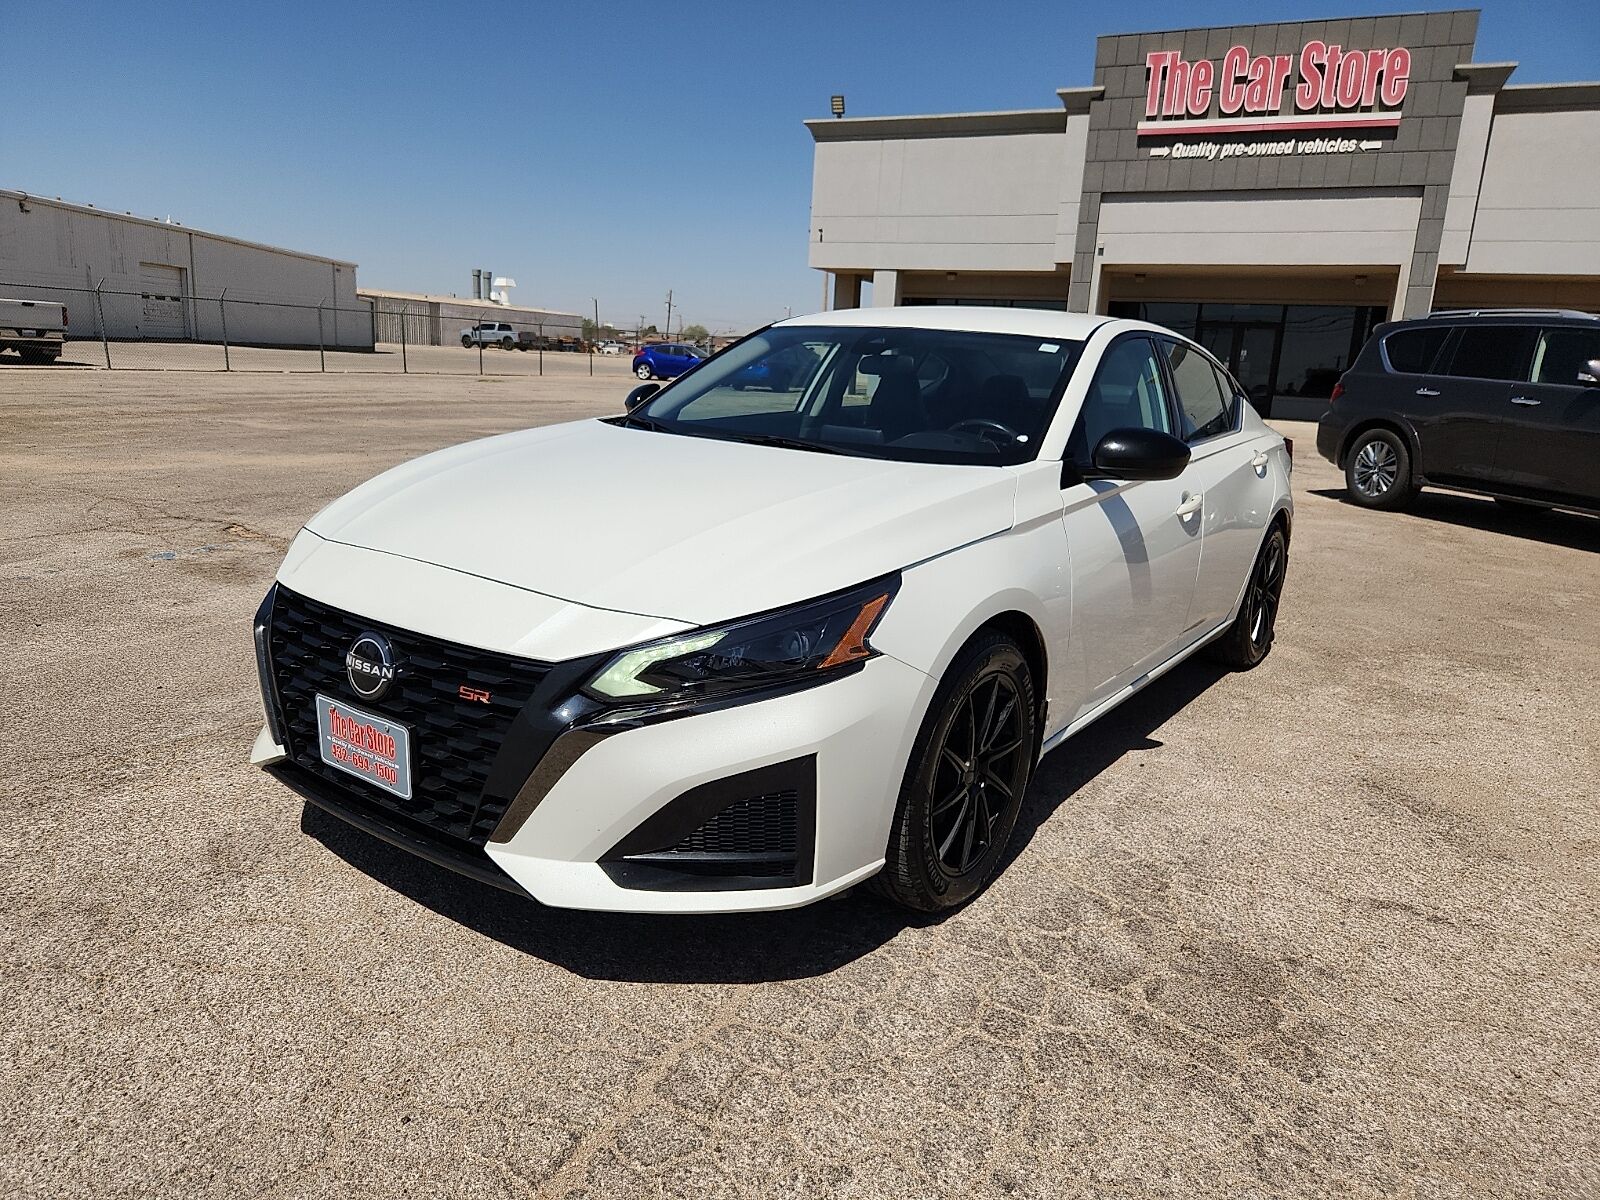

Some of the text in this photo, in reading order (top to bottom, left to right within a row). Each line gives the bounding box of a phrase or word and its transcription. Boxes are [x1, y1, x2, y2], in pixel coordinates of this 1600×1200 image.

[1145, 40, 1411, 116] The Car Store
[1172, 137, 1358, 160] Quality pre-owned vehicles
[345, 652, 394, 678] NISSAN
[459, 685, 490, 704] SR
[329, 706, 396, 761] The Car Store
